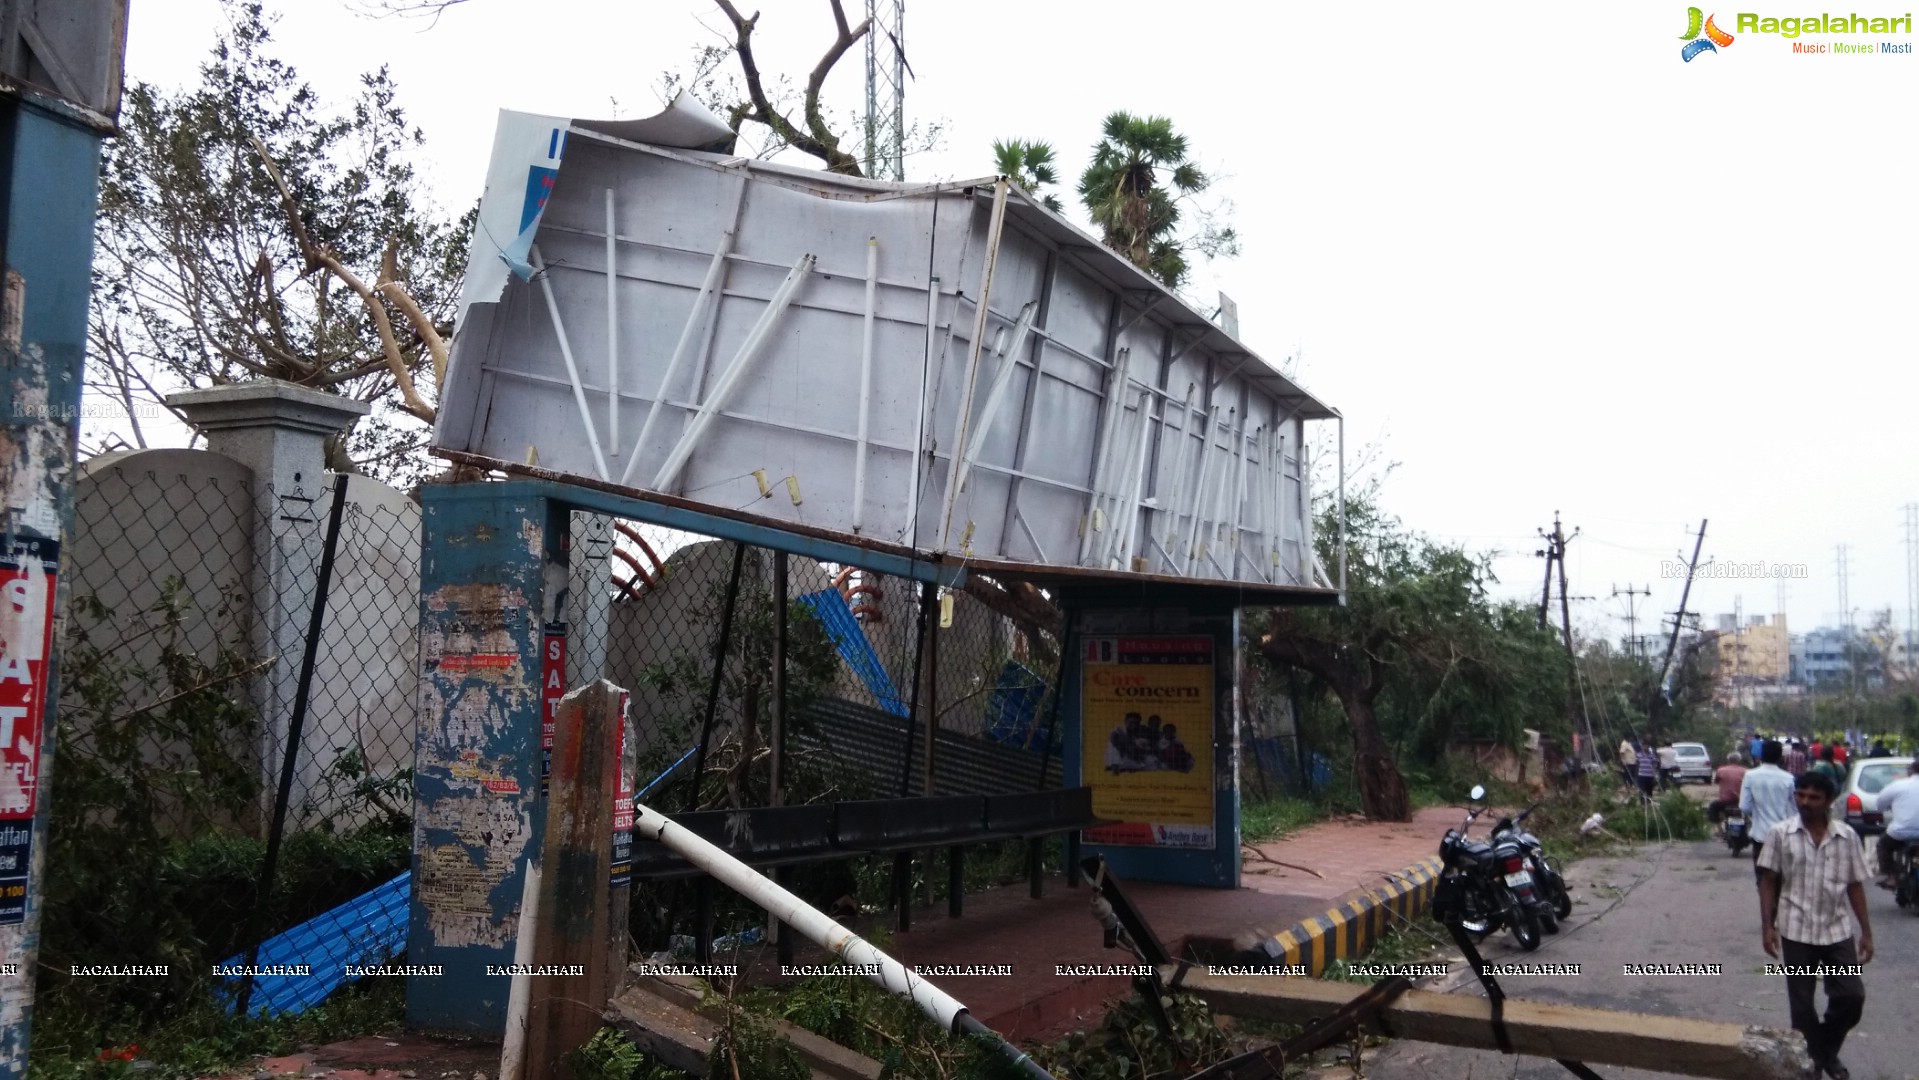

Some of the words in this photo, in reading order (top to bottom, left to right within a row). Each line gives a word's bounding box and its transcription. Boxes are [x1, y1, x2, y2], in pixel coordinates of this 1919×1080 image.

[1093, 671, 1146, 687] Care
[1115, 686, 1200, 697] concern
[615, 799, 634, 811] TOEFL
[615, 815, 633, 828] IELTS
